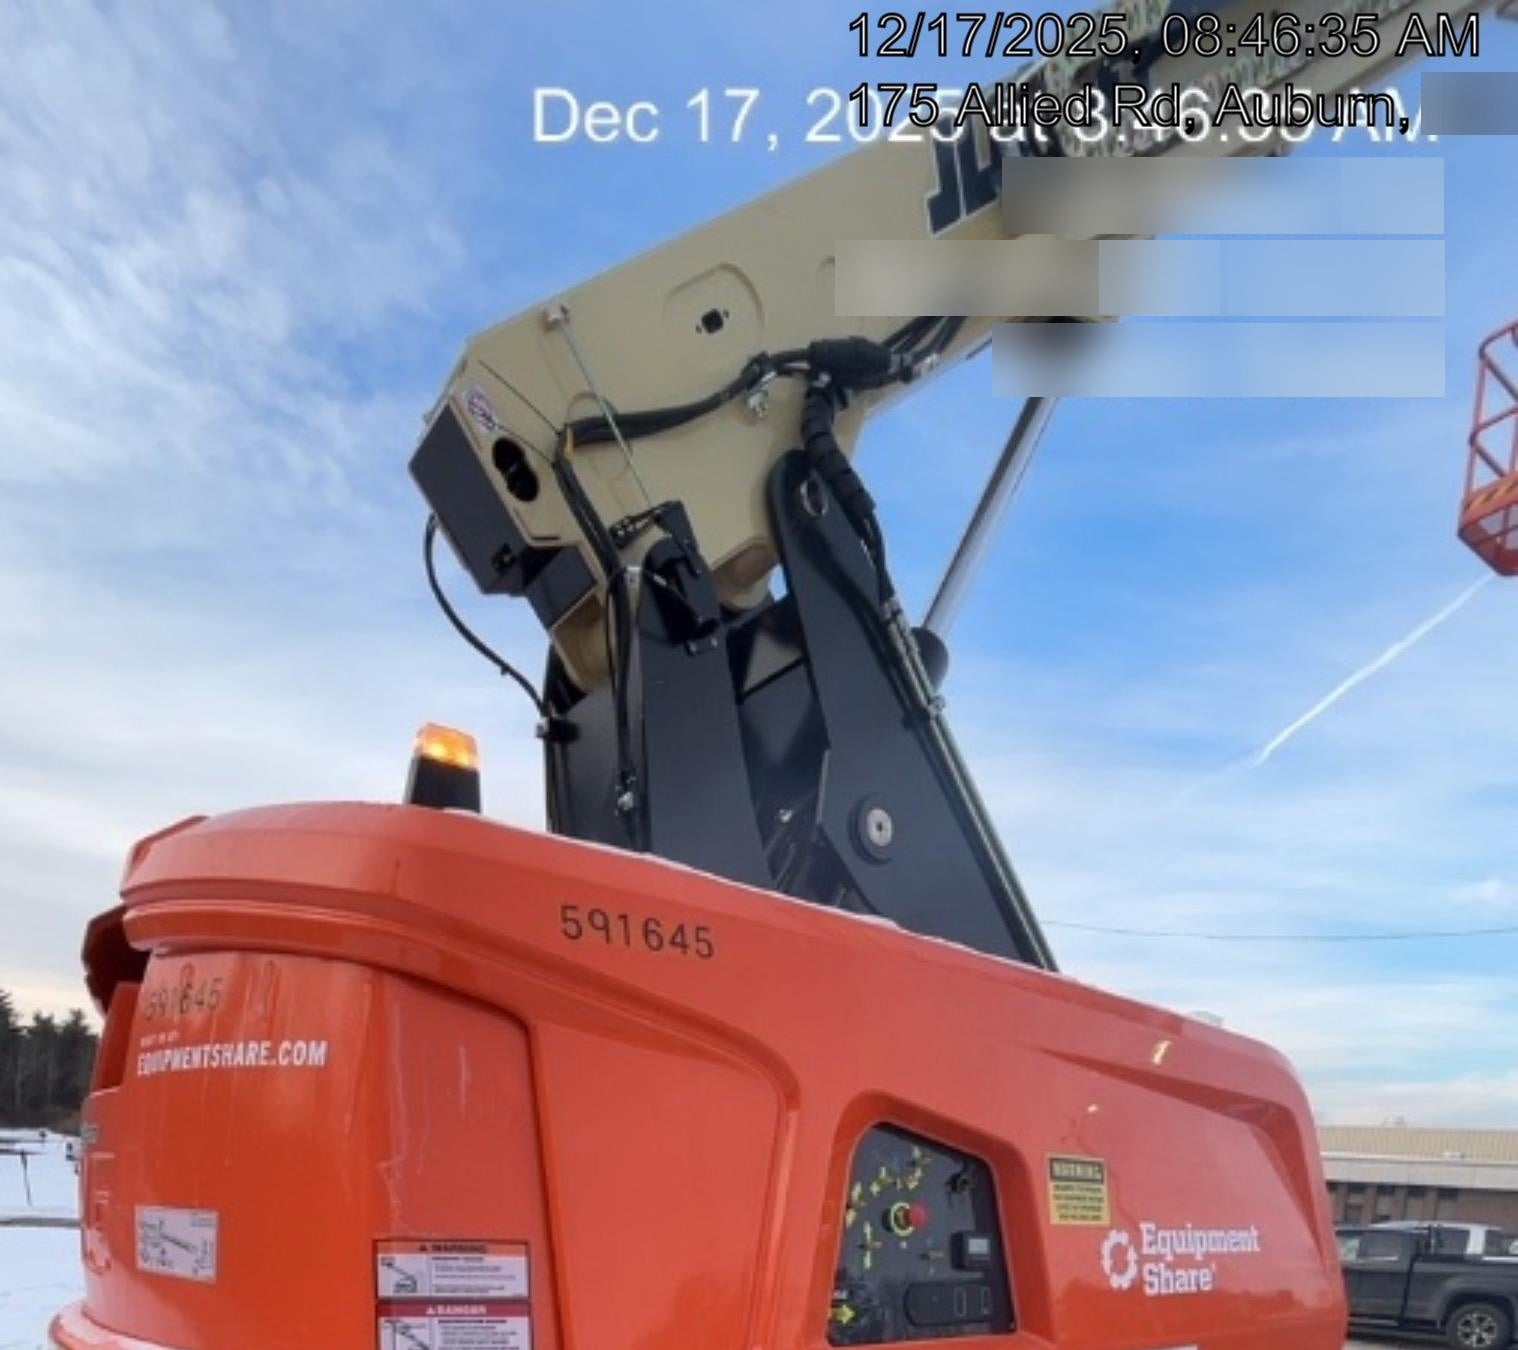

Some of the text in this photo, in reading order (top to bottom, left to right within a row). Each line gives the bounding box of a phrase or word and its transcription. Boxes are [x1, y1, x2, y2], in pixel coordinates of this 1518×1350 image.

[560, 905, 715, 959] 591645
[136, 1040, 329, 1077] EQUIPMENTSHARE.COM
[1139, 1221, 1261, 1262] Equipment
